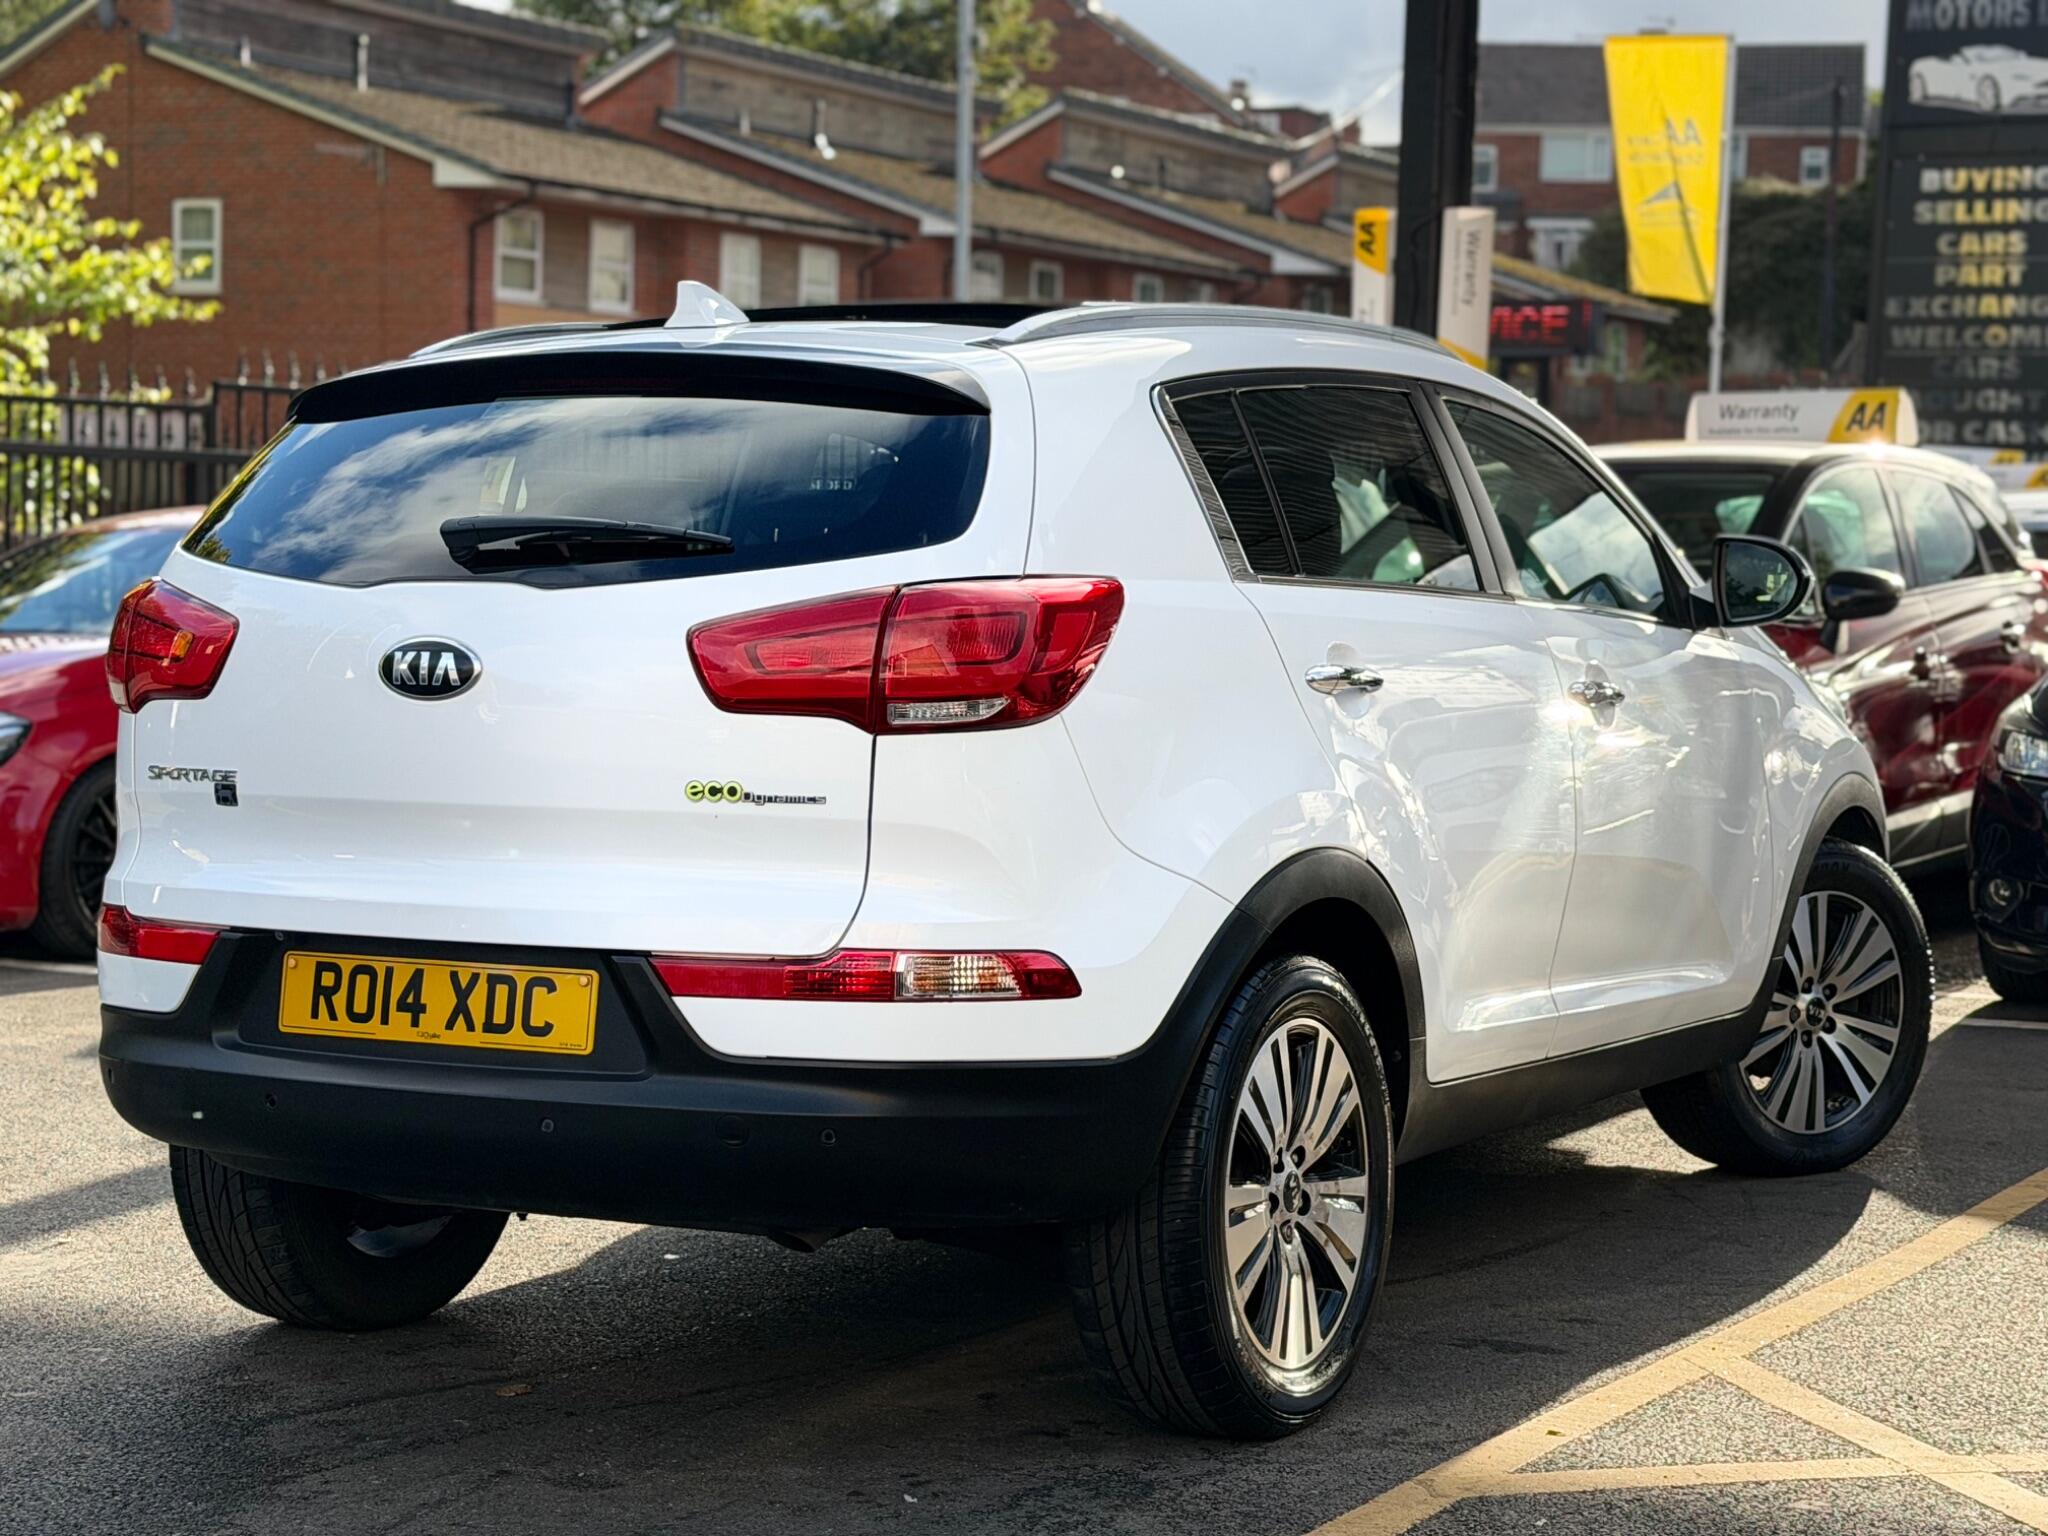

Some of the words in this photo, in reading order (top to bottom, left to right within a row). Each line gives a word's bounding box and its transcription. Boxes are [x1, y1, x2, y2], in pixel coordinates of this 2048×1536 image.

[1906, 0, 2031, 30] MOTORS
[1913, 198, 2048, 225] SELLING
[1359, 221, 1376, 256] AA
[1936, 231, 2028, 255] CARS
[1934, 263, 2025, 287] PART
[1891, 324, 2048, 348] WELCOM
[1933, 355, 2022, 380] CARS
[1718, 403, 1799, 422] Warranty
[1846, 402, 1887, 432] AA
[392, 650, 461, 686] KIA
[147, 764, 238, 783] SPORTAGE
[310, 960, 427, 1028] RO14
[445, 970, 557, 1038] XDC
